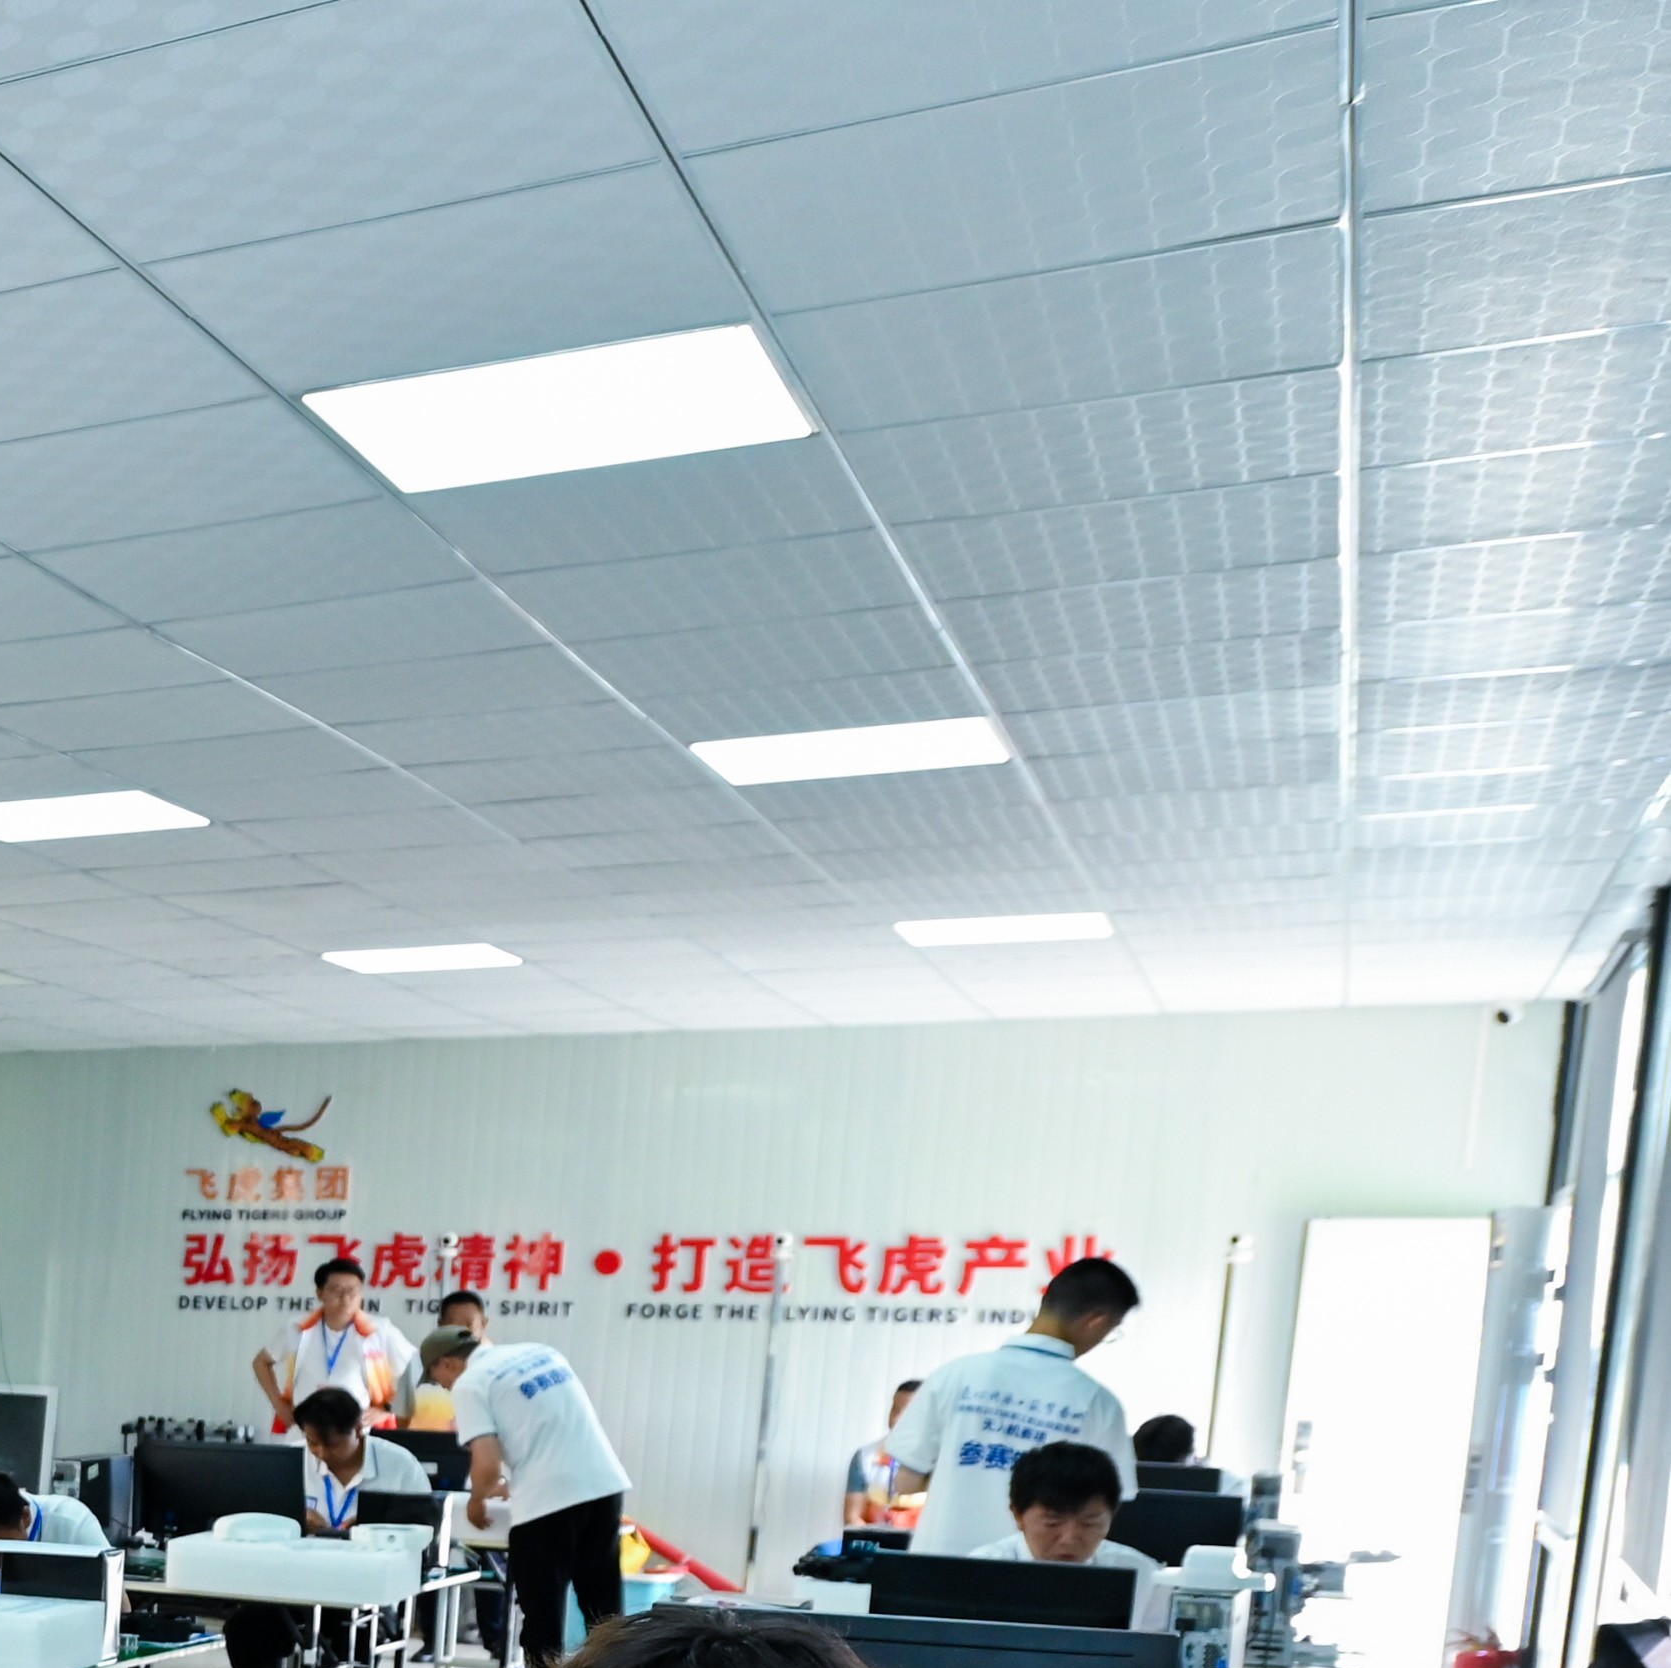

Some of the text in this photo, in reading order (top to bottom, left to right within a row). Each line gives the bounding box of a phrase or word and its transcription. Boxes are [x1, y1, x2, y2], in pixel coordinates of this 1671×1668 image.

[184, 1165, 350, 1202] 飞虎集团
[181, 1209, 347, 1221] FLYING TIGERS GROUP
[178, 1294, 268, 1312] DEVELOP
[276, 1296, 314, 1311] THE
[500, 1300, 574, 1318] SPIRIT
[626, 1303, 704, 1320] FORGE
[715, 1304, 759, 1320] THE
